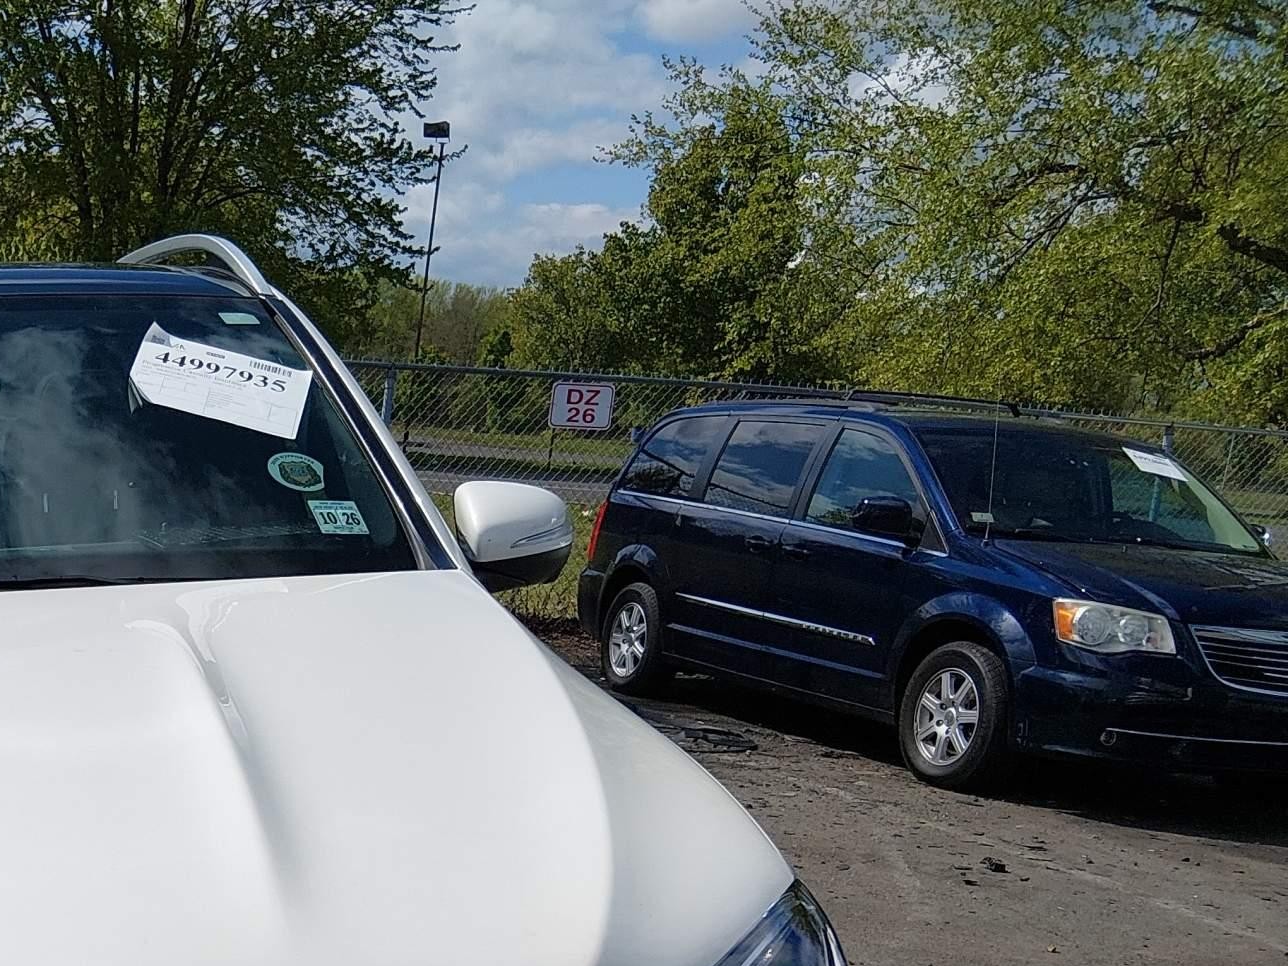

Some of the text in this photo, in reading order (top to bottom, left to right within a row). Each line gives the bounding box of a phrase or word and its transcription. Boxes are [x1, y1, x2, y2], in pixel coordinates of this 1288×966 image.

[154, 352, 287, 393] 44997935
[567, 389, 601, 406] DZ
[567, 407, 595, 423] 26
[319, 512, 360, 526] 10 26
